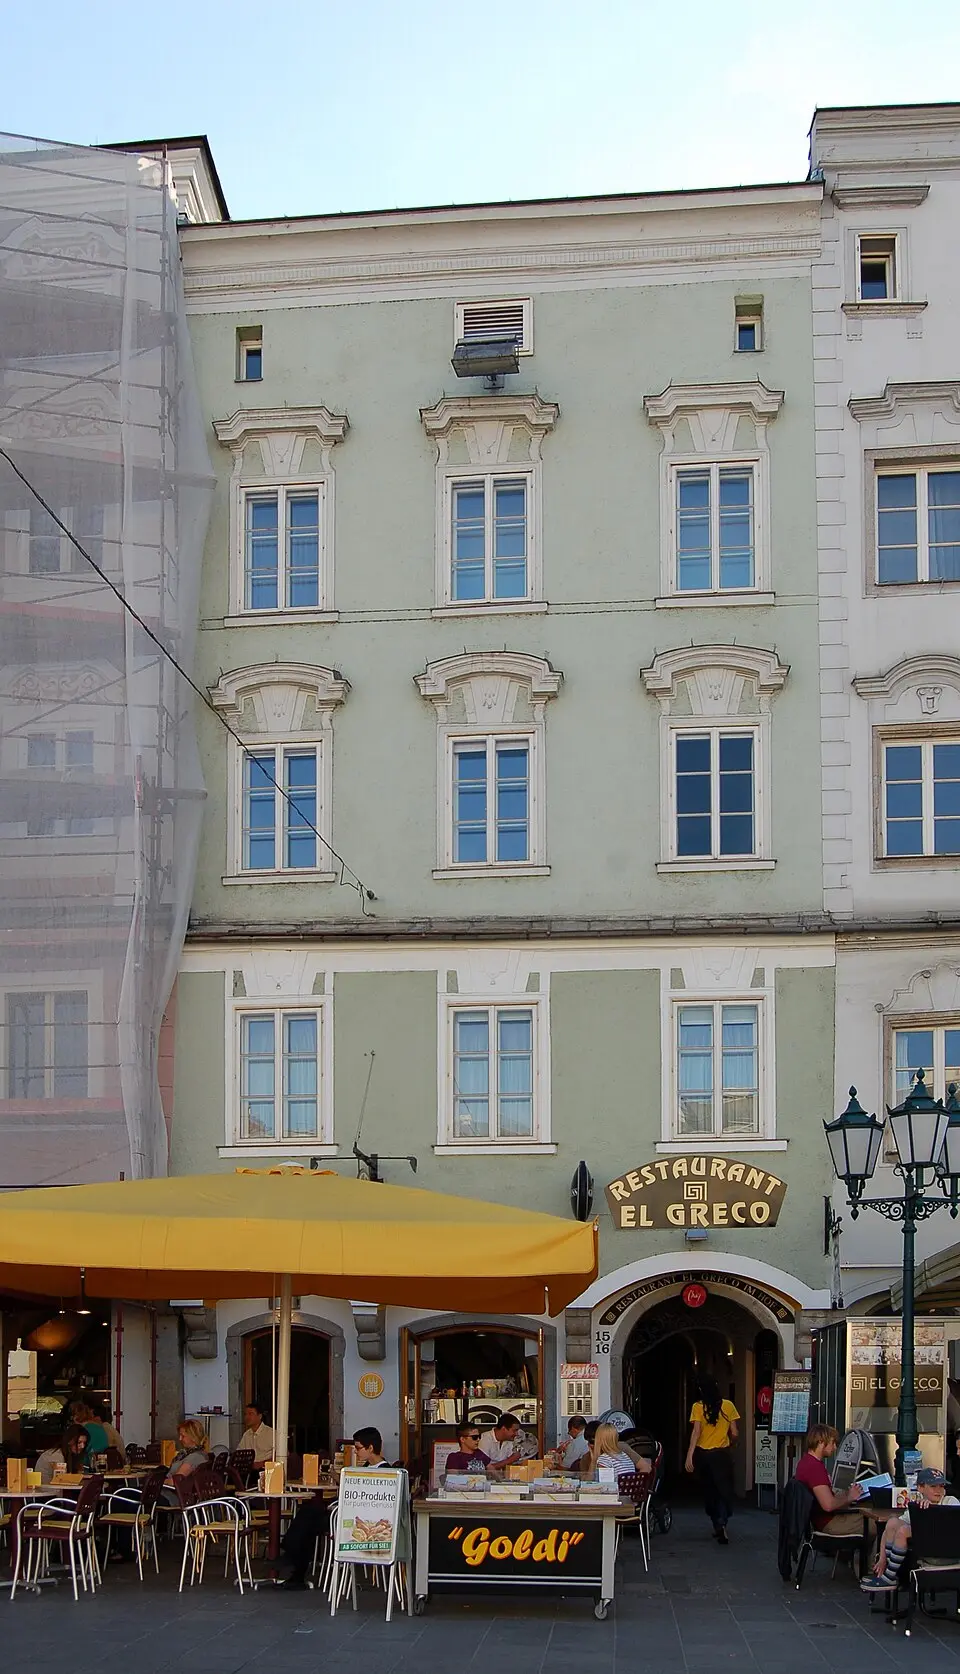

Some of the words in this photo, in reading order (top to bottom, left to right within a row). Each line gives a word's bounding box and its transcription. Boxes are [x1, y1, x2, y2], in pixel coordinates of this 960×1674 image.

[608, 1157, 782, 1202] RESTAURANT
[620, 1204, 653, 1228] EL
[666, 1201, 770, 1228] GRECO
[615, 1275, 677, 1312] RESTAURANT
[682, 1273, 696, 1282] EL
[701, 1273, 740, 1289] GRECO
[743, 1284, 757, 1297] IM
[757, 1292, 778, 1310] HOF
[595, 1331, 611, 1342] 15
[595, 1343, 610, 1354] 16
[562, 1364, 598, 1376] Heute
[869, 1377, 886, 1390] EL
[889, 1377, 939, 1390] GECO
[344, 1477, 361, 1485] NEUE
[344, 1490, 396, 1502] BIO-Produkte
[369, 1541, 379, 1549] FÜR
